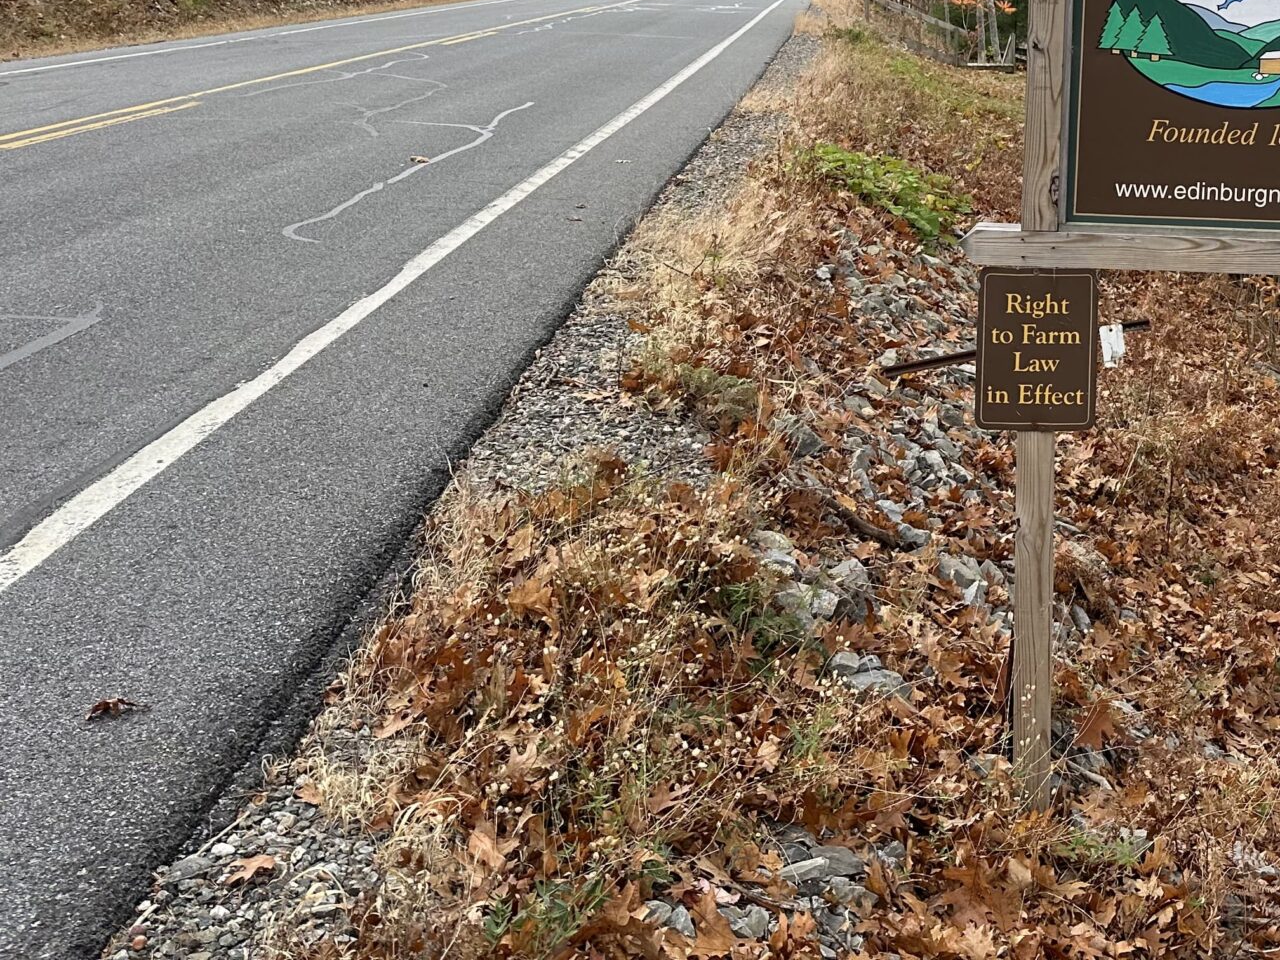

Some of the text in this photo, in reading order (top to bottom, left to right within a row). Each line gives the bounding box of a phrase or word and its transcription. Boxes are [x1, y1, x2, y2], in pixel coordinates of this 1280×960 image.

[1146, 119, 1258, 146] Founded
[1005, 293, 1070, 319] Right
[991, 324, 1081, 345] to Farm
[1012, 351, 1060, 372] Law
[986, 383, 1084, 406] in Effect
